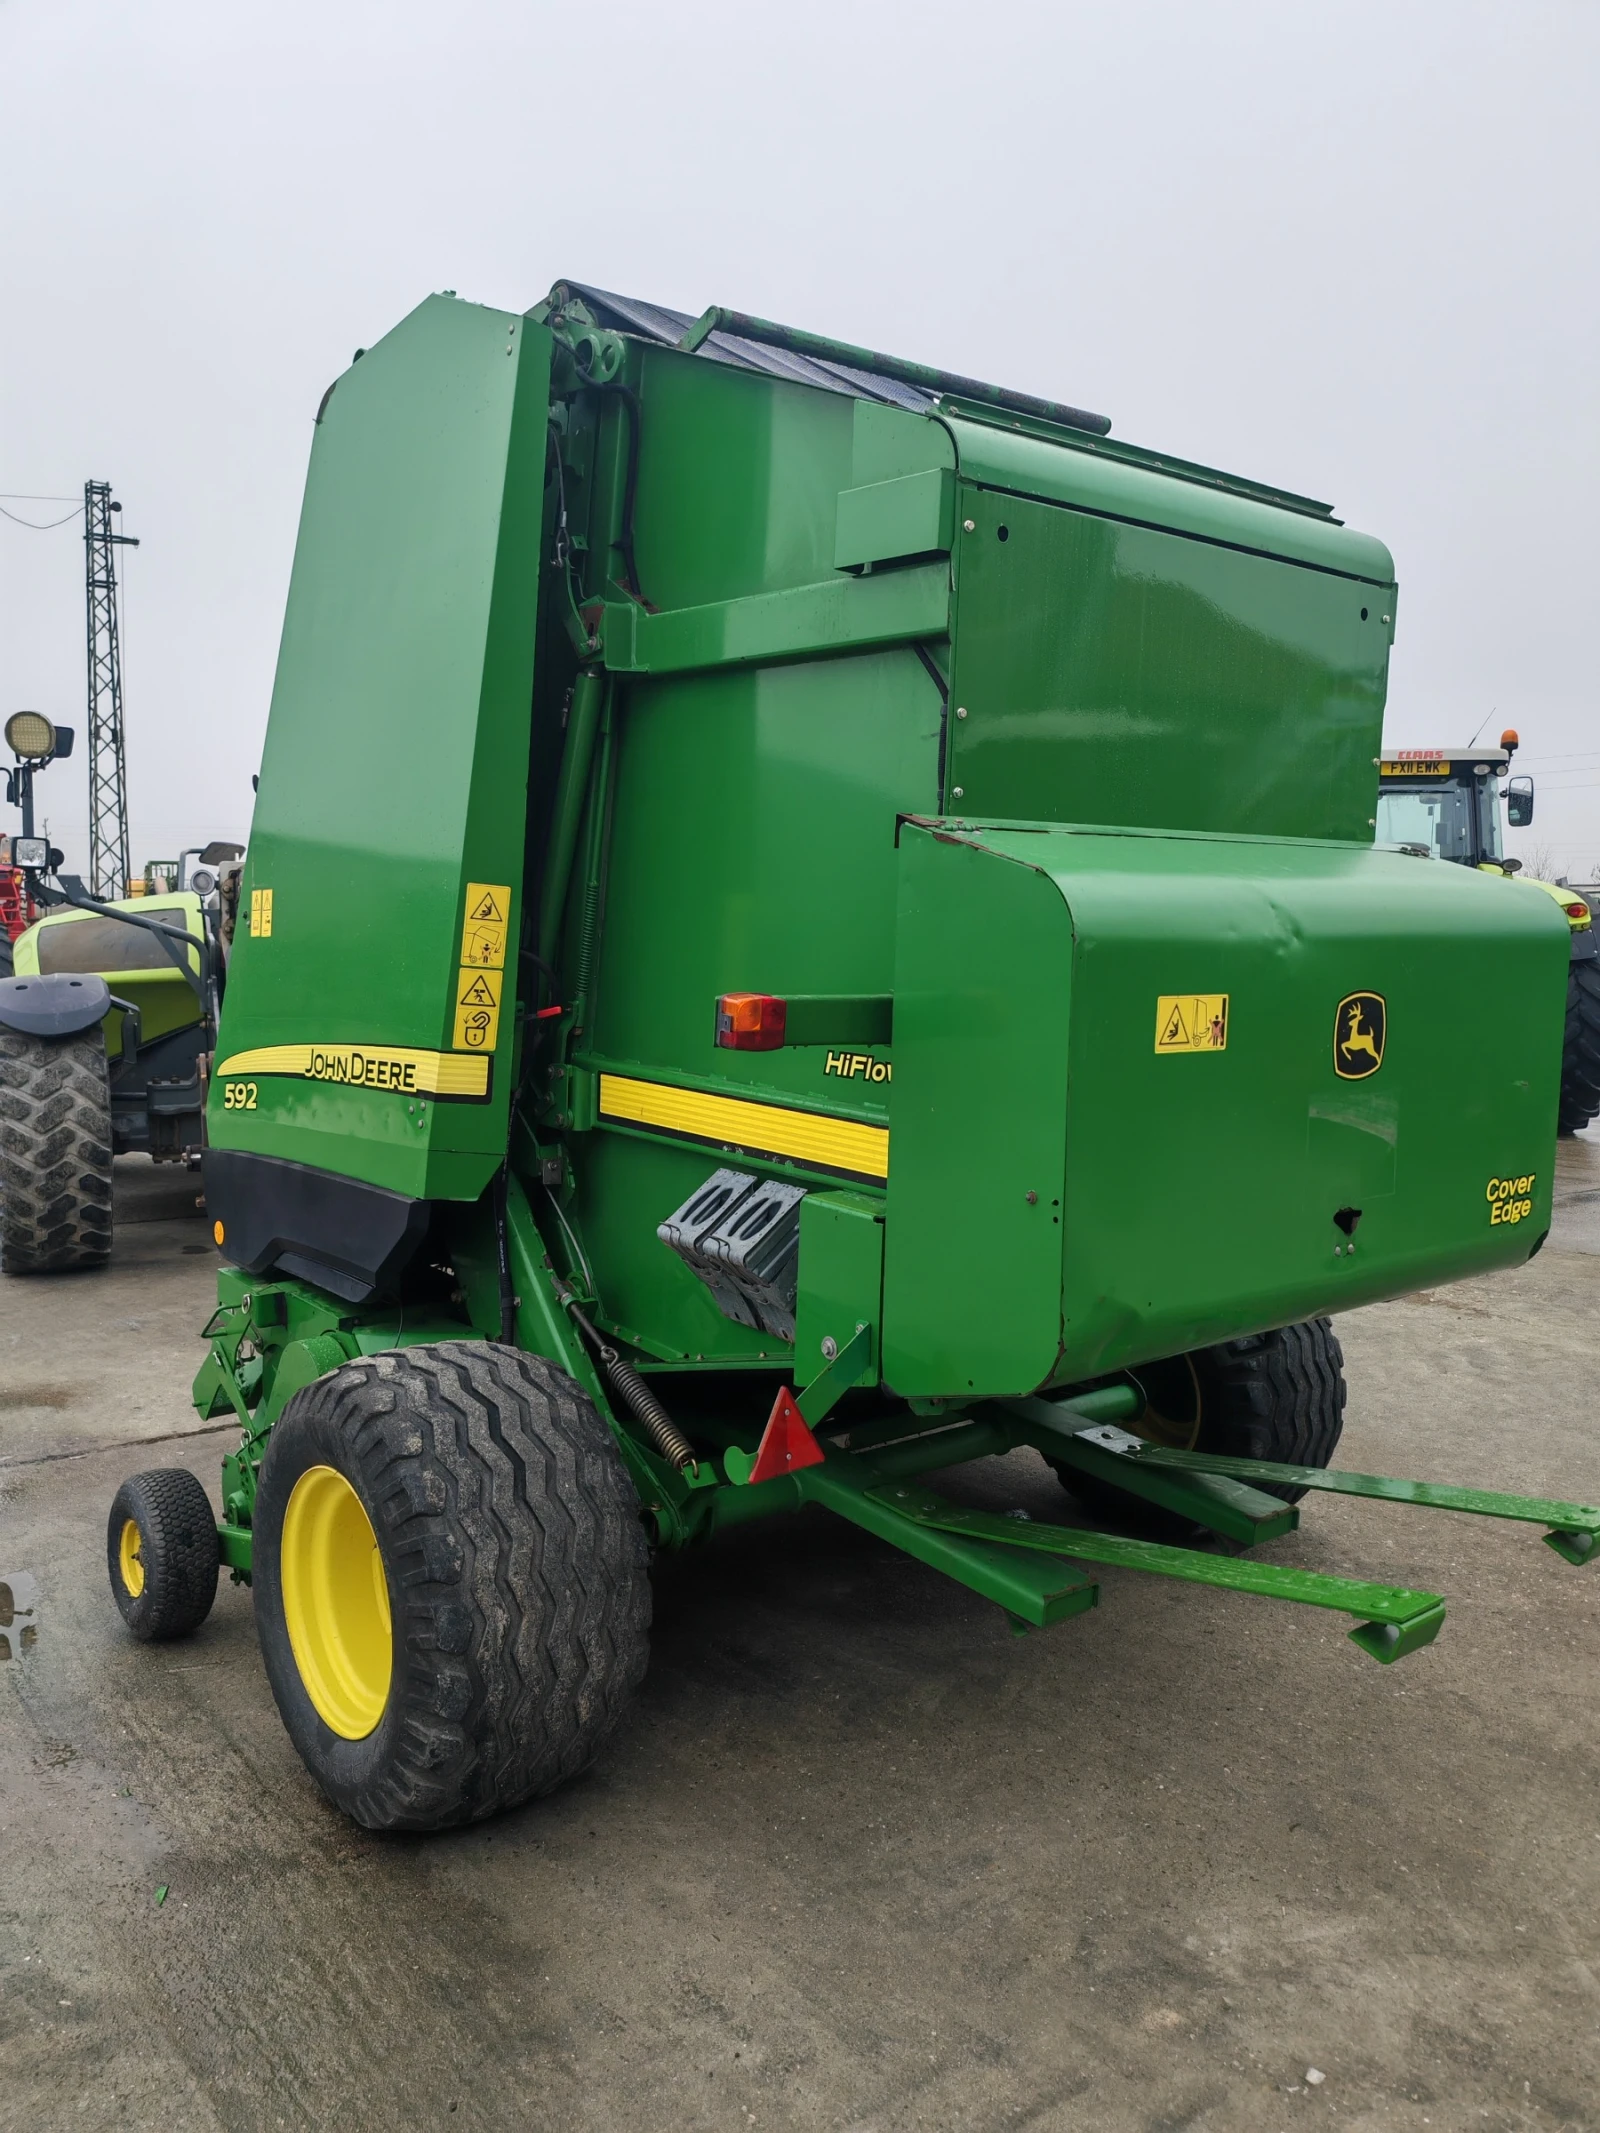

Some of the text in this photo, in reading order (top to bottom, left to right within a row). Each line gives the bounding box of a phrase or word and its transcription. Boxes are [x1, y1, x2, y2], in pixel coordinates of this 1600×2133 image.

[1390, 761, 1441, 774] FX11 EWK
[1397, 750, 1444, 760] CLAAS
[305, 1048, 416, 1089] JOHN DEERE
[224, 1082, 258, 1110] 592
[1486, 1174, 1536, 1202] Cover
[1490, 1198, 1532, 1226] Edge
